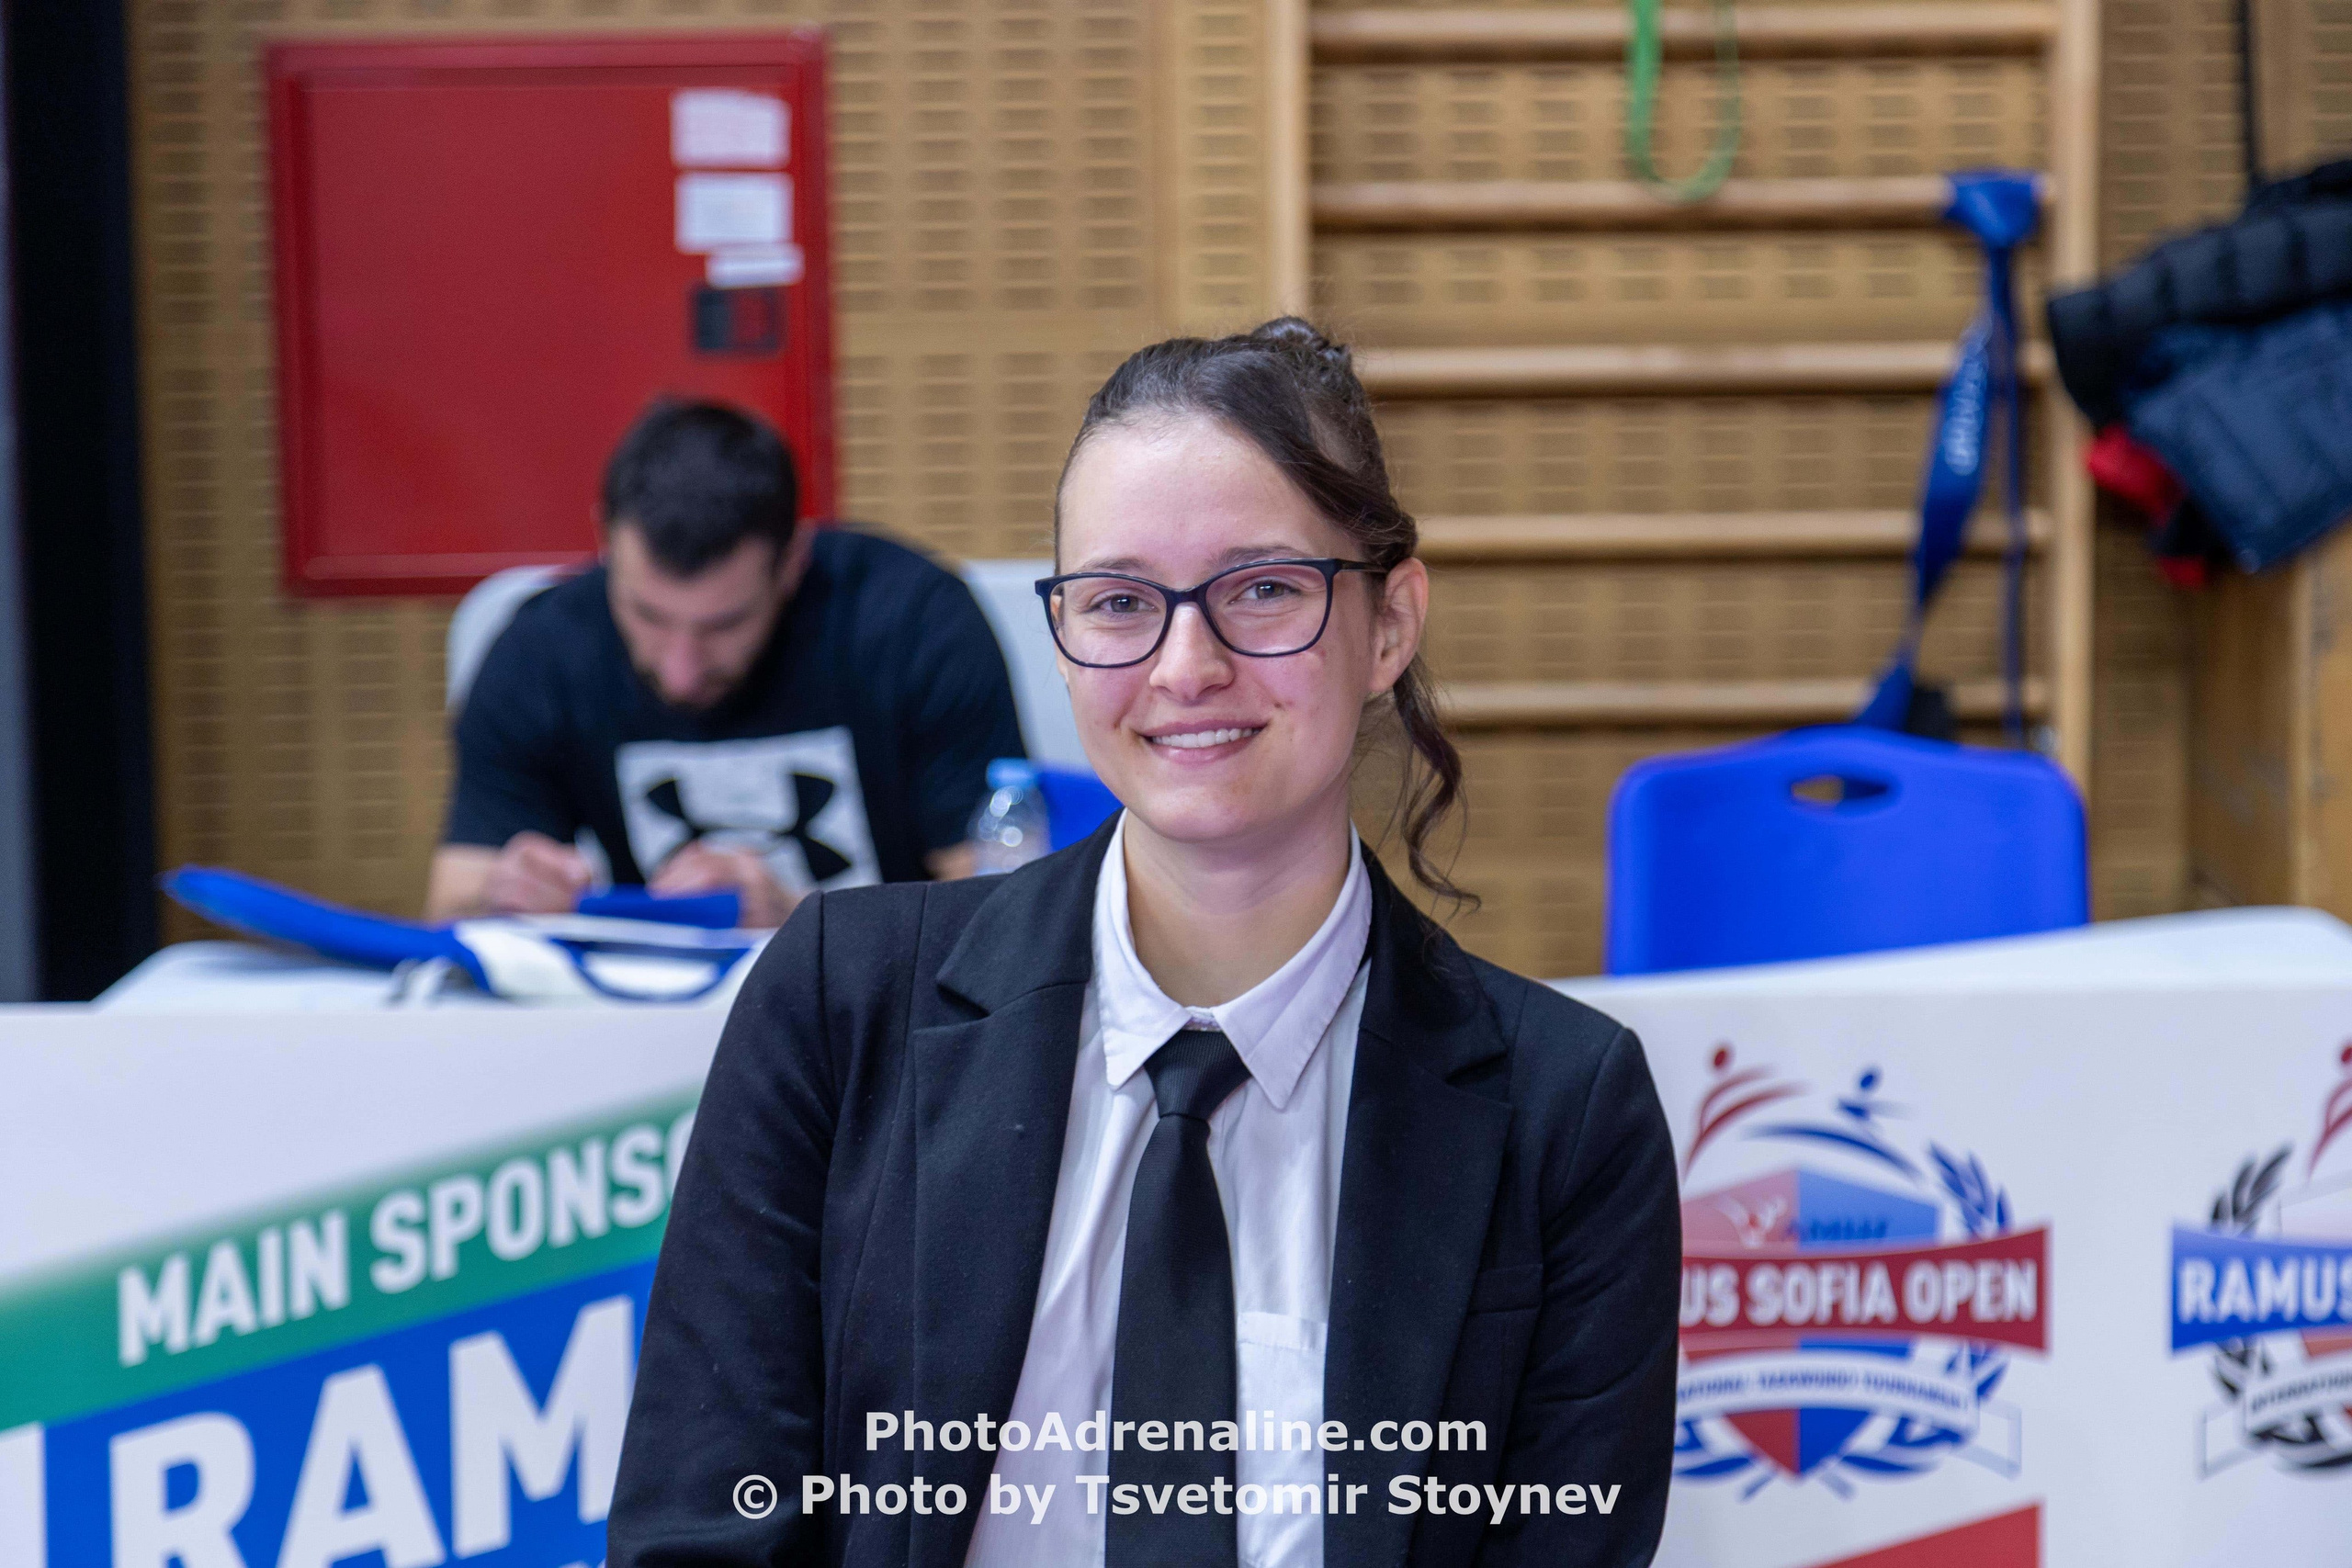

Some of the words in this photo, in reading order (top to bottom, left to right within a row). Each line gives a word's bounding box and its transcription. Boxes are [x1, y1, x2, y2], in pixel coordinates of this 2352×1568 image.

[117, 1208, 351, 1368] MAIN
[1747, 1260, 1899, 1326] SOFIA
[1902, 1258, 2038, 1324] OPEN
[107, 1292, 634, 1568] RAM
